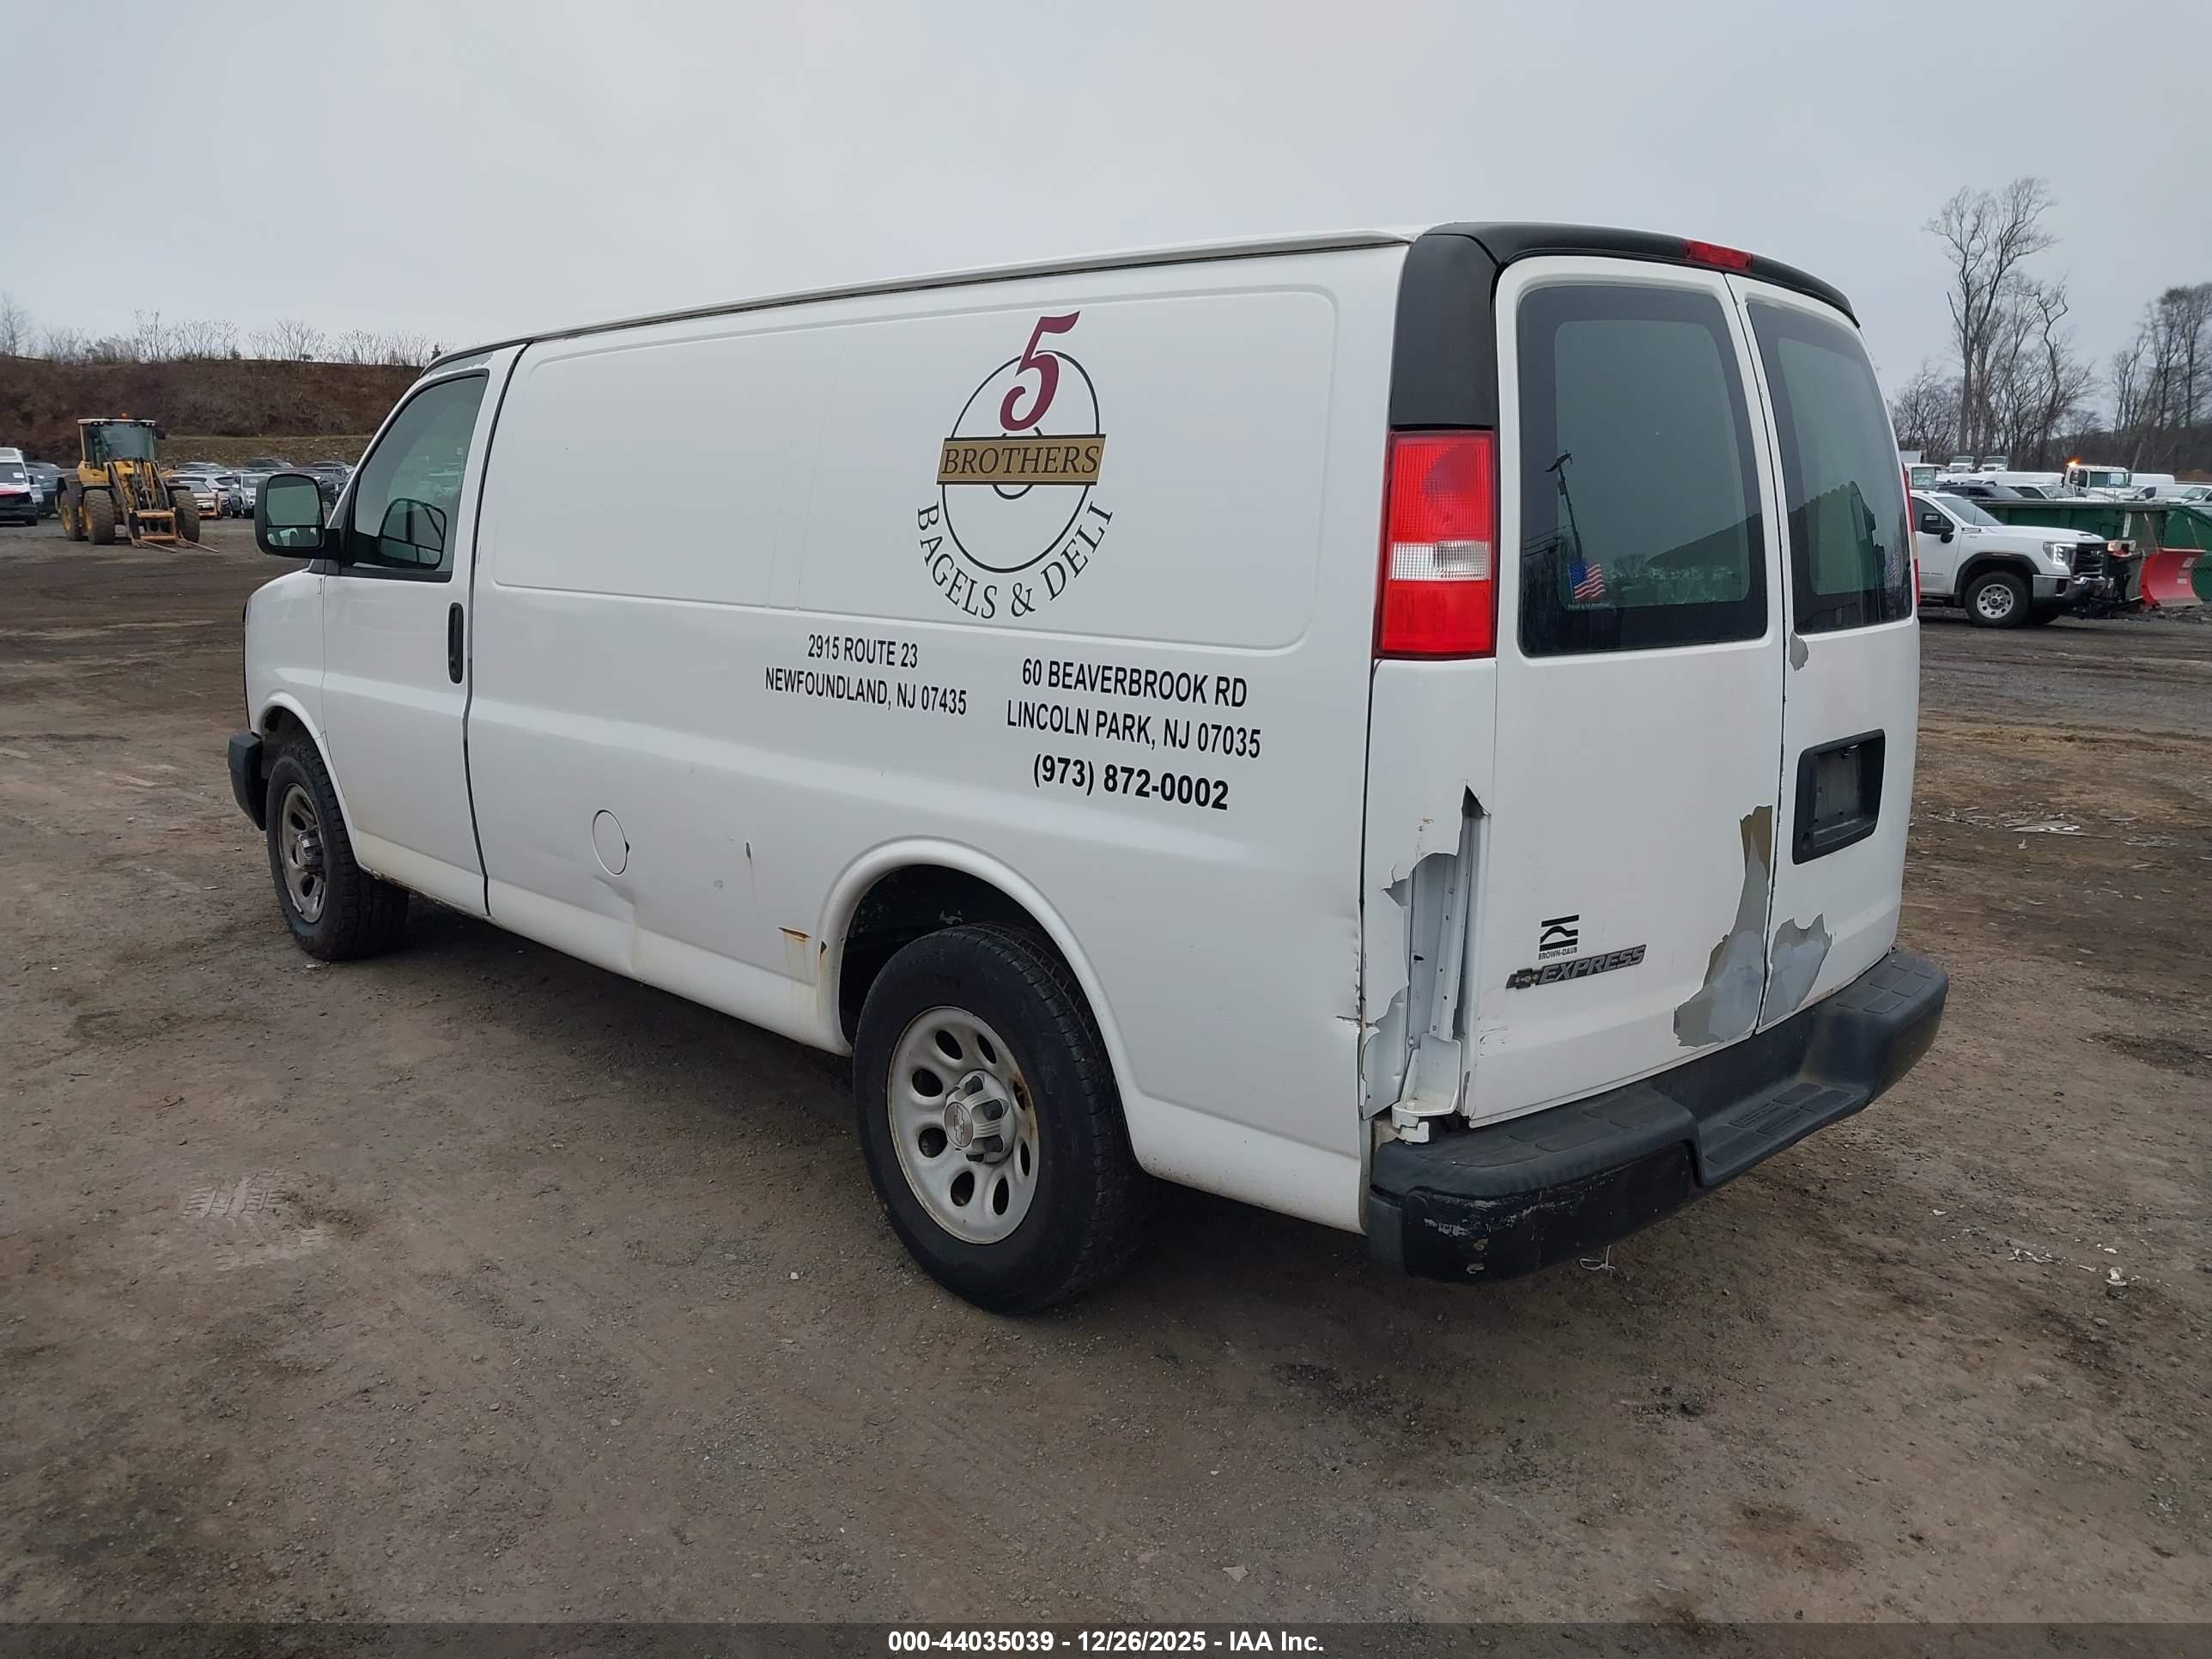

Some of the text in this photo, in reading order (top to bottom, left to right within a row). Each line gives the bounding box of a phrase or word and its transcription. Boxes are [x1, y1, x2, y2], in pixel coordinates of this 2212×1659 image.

[1000, 309, 1080, 431] 5
[941, 445, 1100, 474] BROTHERS
[916, 501, 1113, 619] BAGELS & DELI
[807, 634, 918, 668] 2915 ROUTE 23
[765, 666, 967, 715] NEWFOUNDLAND, NJ 07435
[1022, 658, 1247, 708] 60 BEAVERBROOK RD
[1007, 700, 1261, 759] LINCOLN PARK, NJ 07035
[1033, 753, 1229, 811] (973) 872-0002
[1539, 945, 1646, 985] EXPRESS
